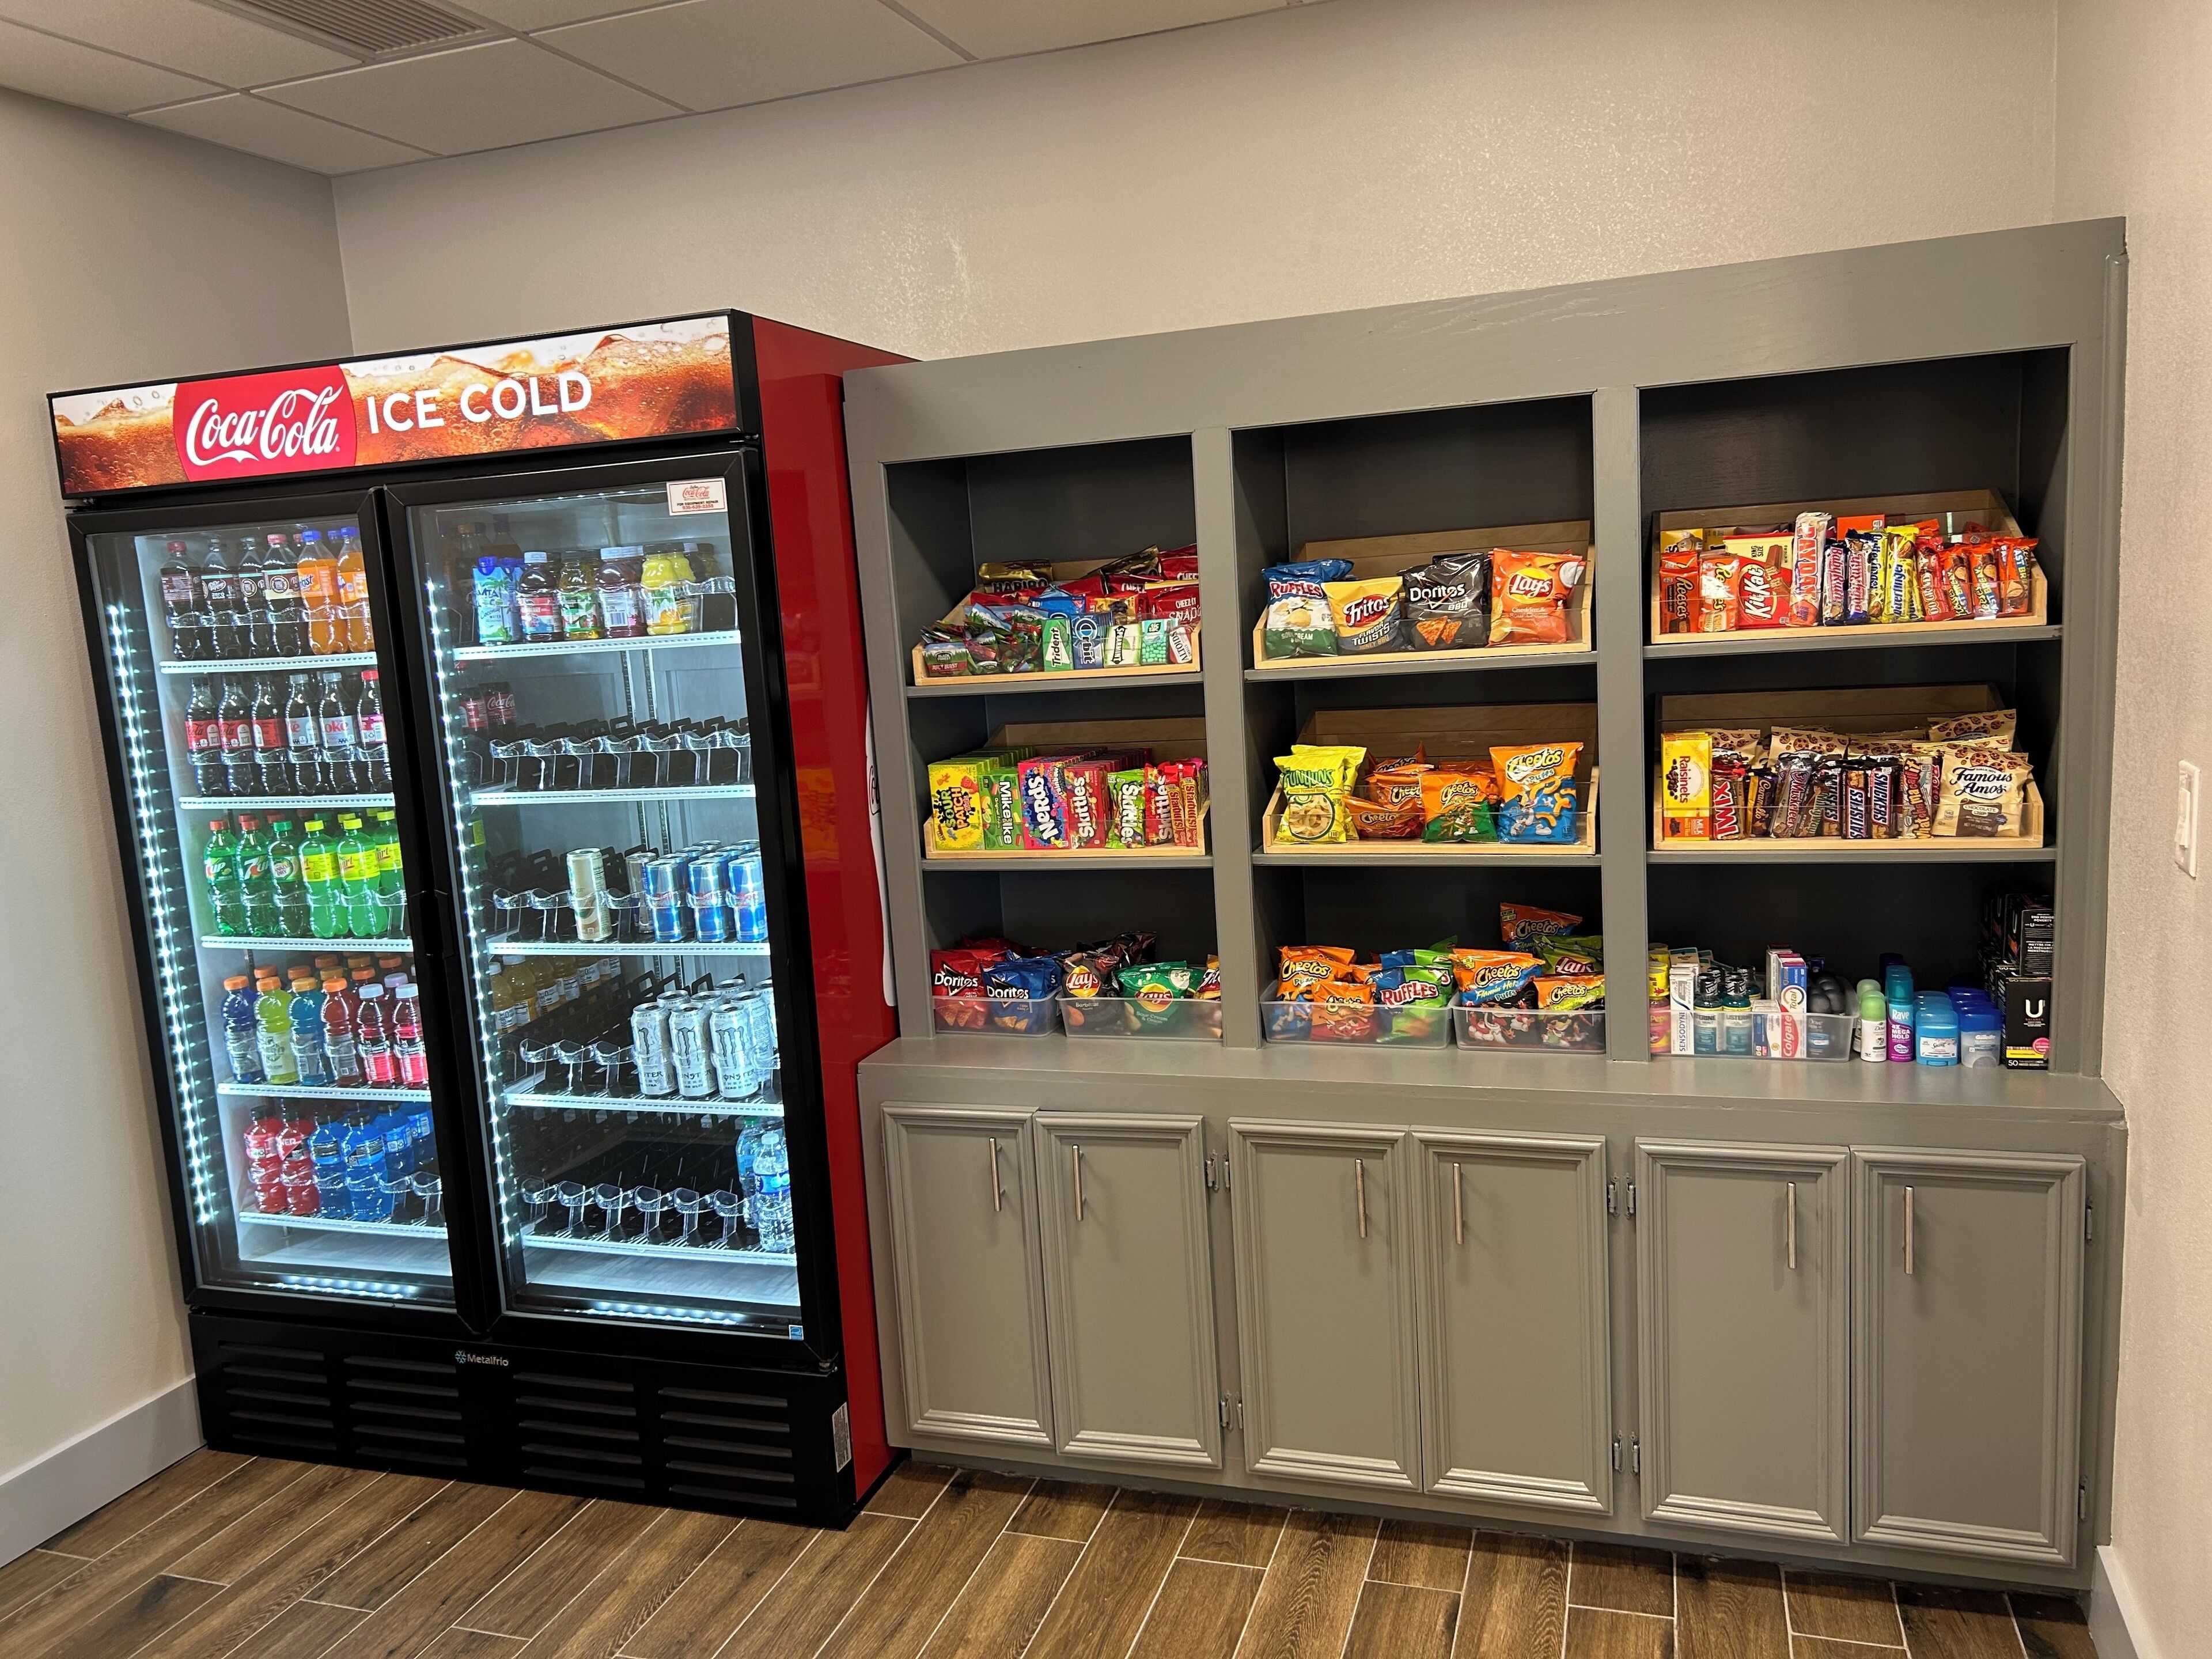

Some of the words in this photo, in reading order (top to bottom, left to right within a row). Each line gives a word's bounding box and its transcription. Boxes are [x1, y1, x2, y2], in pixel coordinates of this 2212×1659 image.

[367, 387, 441, 435] ICE
[460, 372, 593, 424] COLD
[185, 384, 344, 467] Coca-Cola
[991, 577, 1049, 593] HARIBO
[1270, 581, 1324, 600] RUFFLES
[1410, 582, 1465, 602] Doritos
[1343, 596, 1391, 627] Fritos
[1448, 600, 1468, 611] BBQ
[1075, 618, 1098, 665] Orbit
[1113, 627, 1124, 662] SPEARMINT
[1171, 631, 1190, 662] ALTOIDS
[1351, 622, 1391, 646] TWISTS
[1377, 635, 1389, 645] BBQ
[1051, 627, 1060, 668] Trident
[1679, 755, 1691, 804] Raisinets
[1950, 767, 2013, 785] Famous
[999, 781, 1014, 819] Mike
[1873, 773, 1888, 824] SNICKERS
[1955, 782, 2007, 797] Amos
[941, 790, 956, 828] SOUR
[951, 787, 970, 830] PATCH
[1074, 776, 1095, 838] Skittles
[1120, 784, 1139, 844] Skittles
[1155, 775, 1173, 840] Skittles
[1169, 791, 1183, 830] Starburst
[1185, 785, 1197, 831] Starburst
[1713, 781, 1739, 838] TWIX
[1964, 805, 1997, 813] CHOCOLATE
[1516, 919, 1559, 938] Cheetos
[934, 972, 978, 987] Doritos
[1282, 959, 1331, 980] Cheetos
[1475, 964, 1521, 986] Cheetos
[986, 985, 1029, 999] Doritos
[1380, 982, 1439, 1007] RUFFLES
[1495, 990, 1517, 1002] Puffs
[1551, 986, 1587, 1003] Cheetos
[1892, 1009, 1910, 1021] Rave
[2025, 999, 2043, 1018] U
[1782, 1014, 1793, 1056] Colgate
[467, 1354, 509, 1366] Metalfrio
